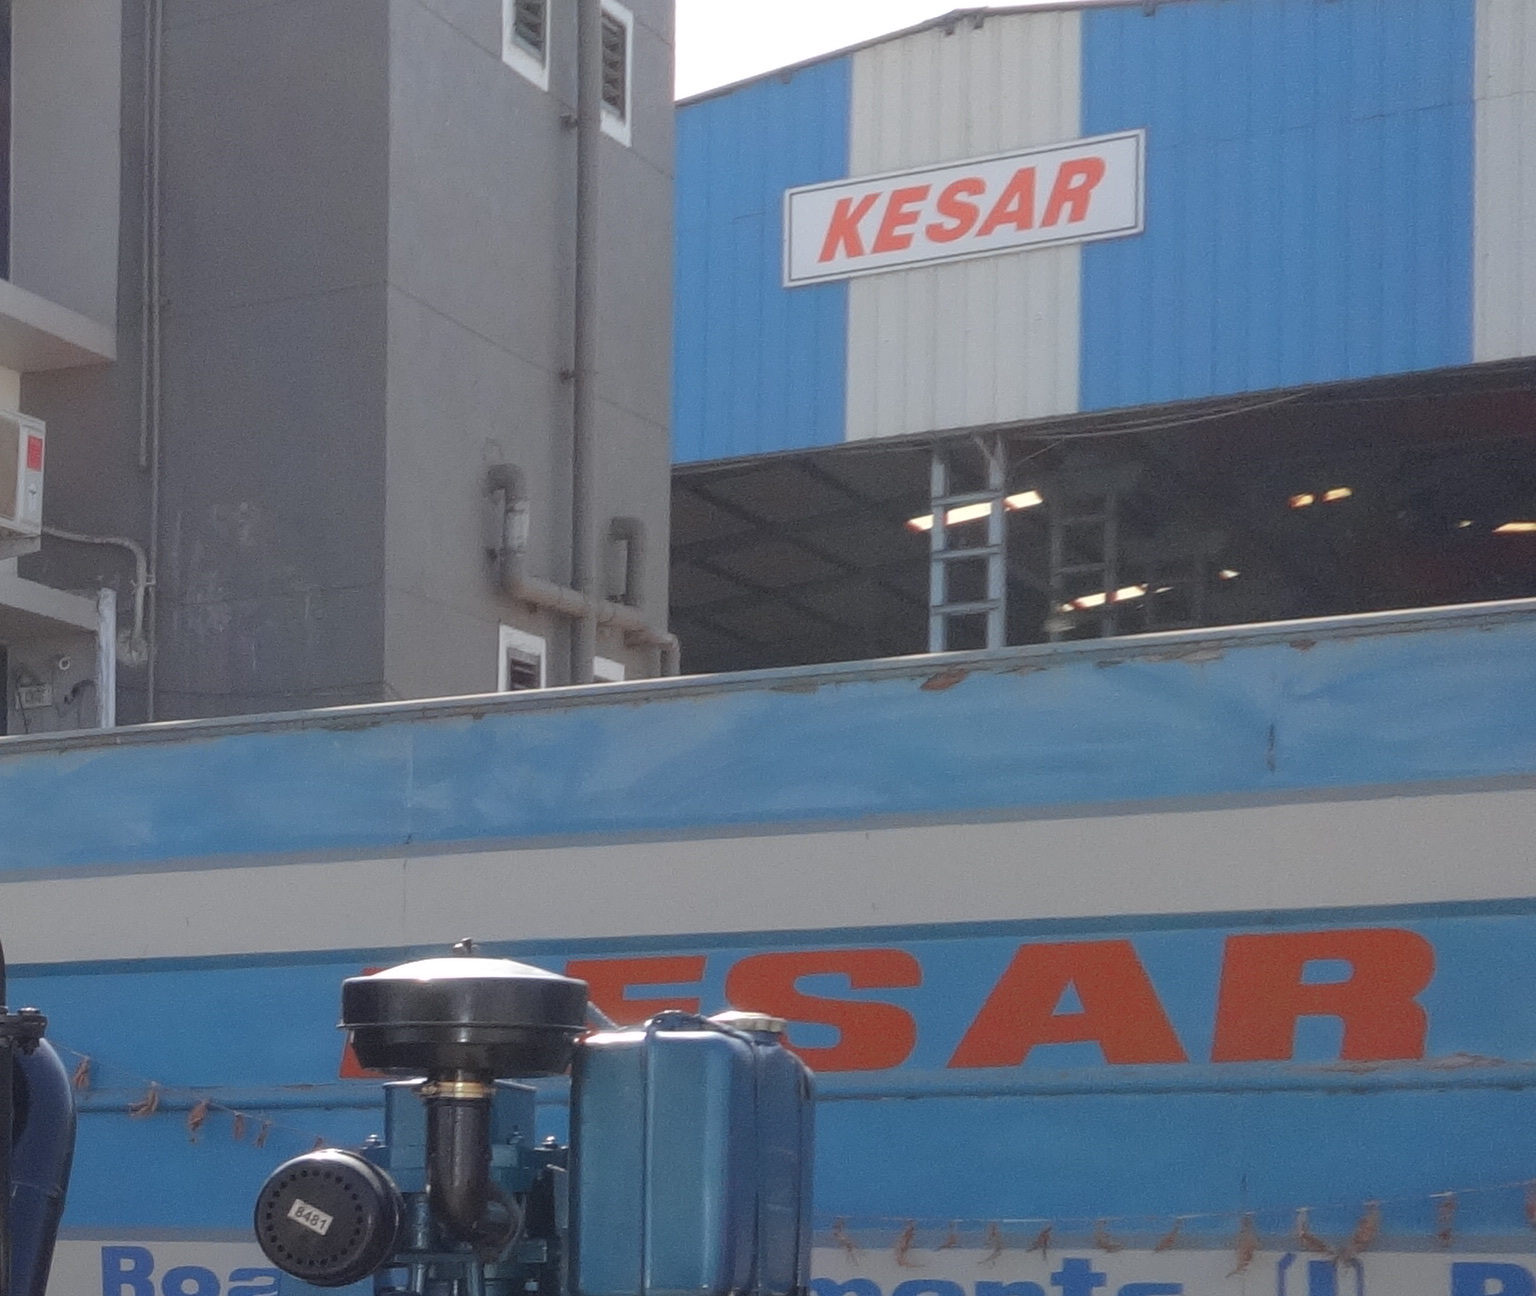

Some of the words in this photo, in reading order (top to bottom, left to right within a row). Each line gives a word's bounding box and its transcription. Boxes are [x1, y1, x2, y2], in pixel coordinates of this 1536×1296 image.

[817, 157, 1105, 263] KESAR
[340, 928, 1435, 1078] SAR
[294, 1206, 328, 1230] 8481
